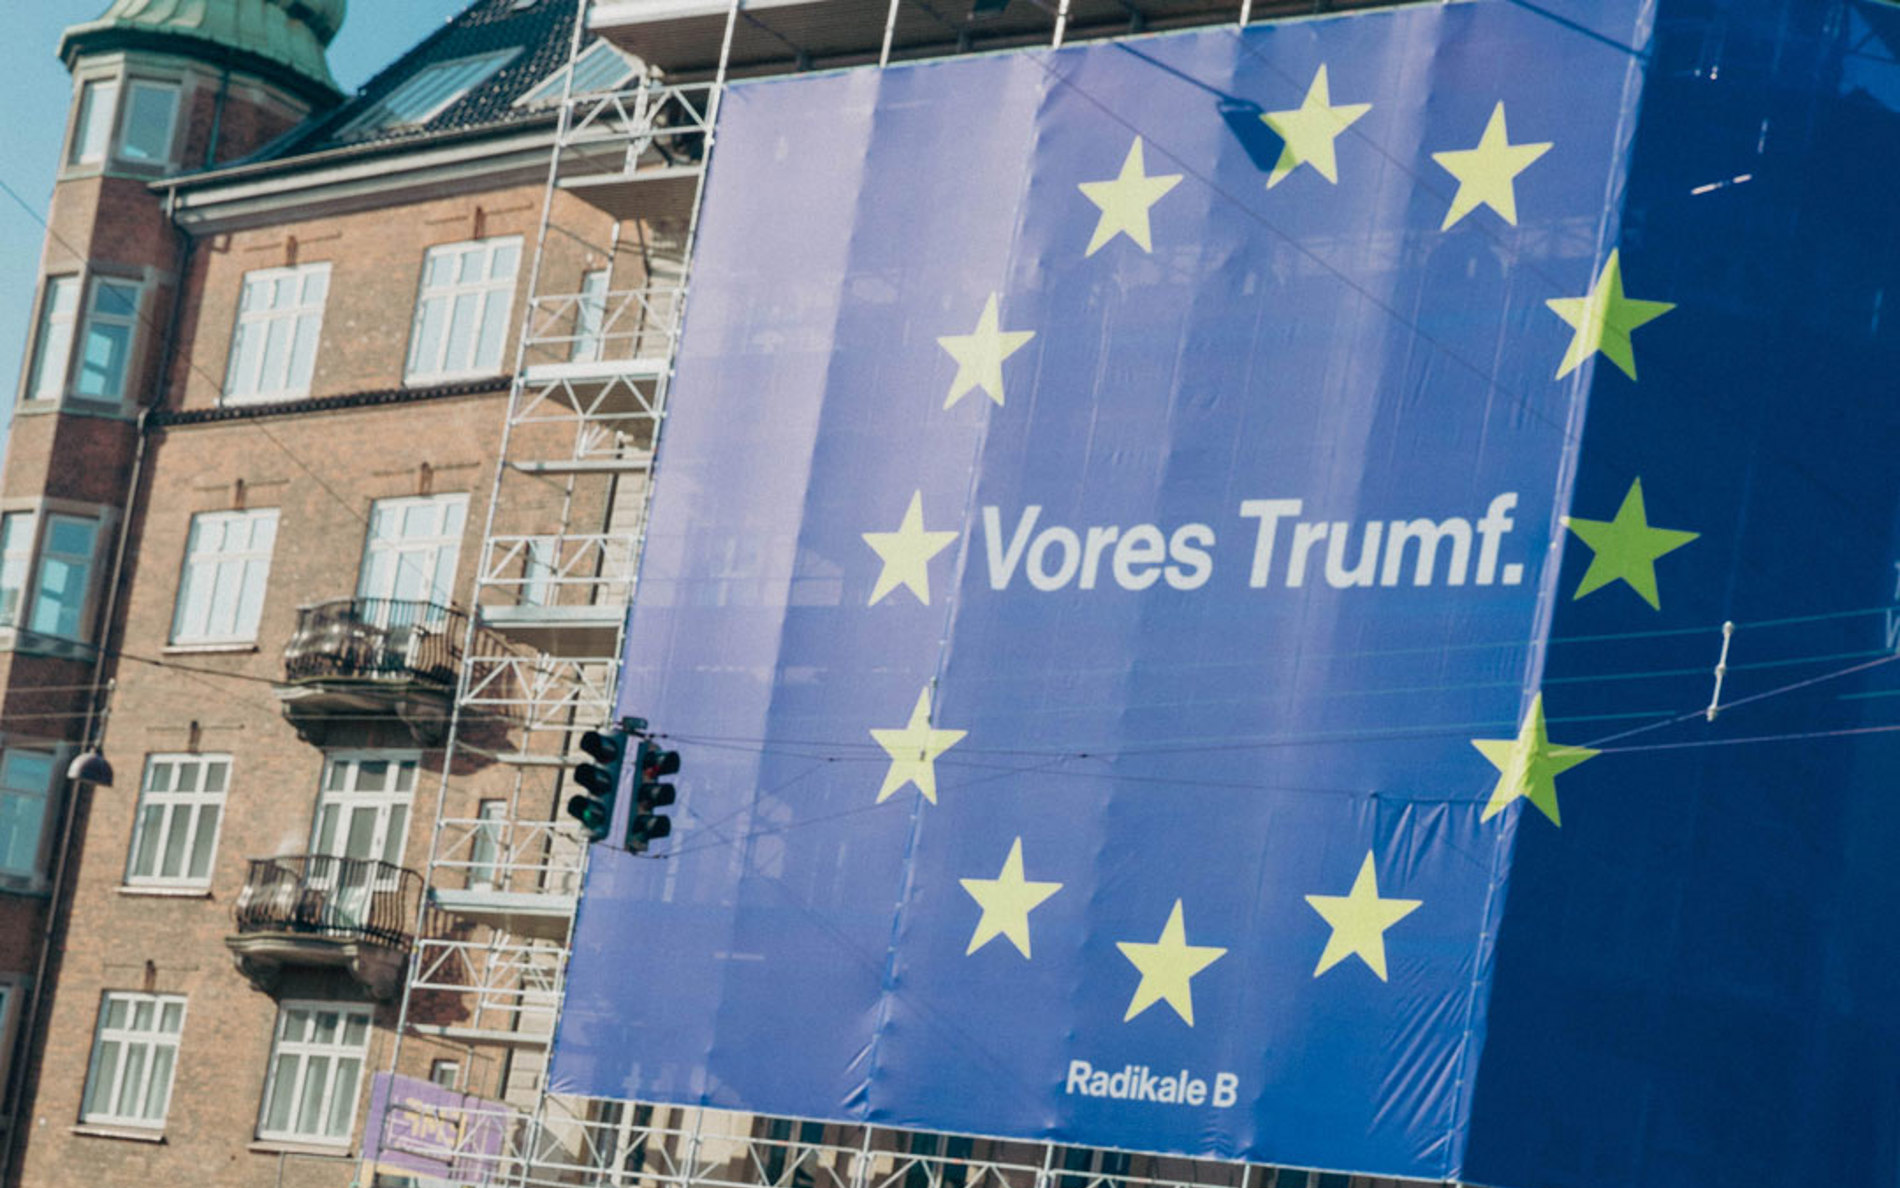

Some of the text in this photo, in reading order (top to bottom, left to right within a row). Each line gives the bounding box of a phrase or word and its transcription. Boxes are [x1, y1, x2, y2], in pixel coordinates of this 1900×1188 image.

[982, 492, 1524, 592] Vores Trumf.
[1065, 1059, 1239, 1108] Radikale B
